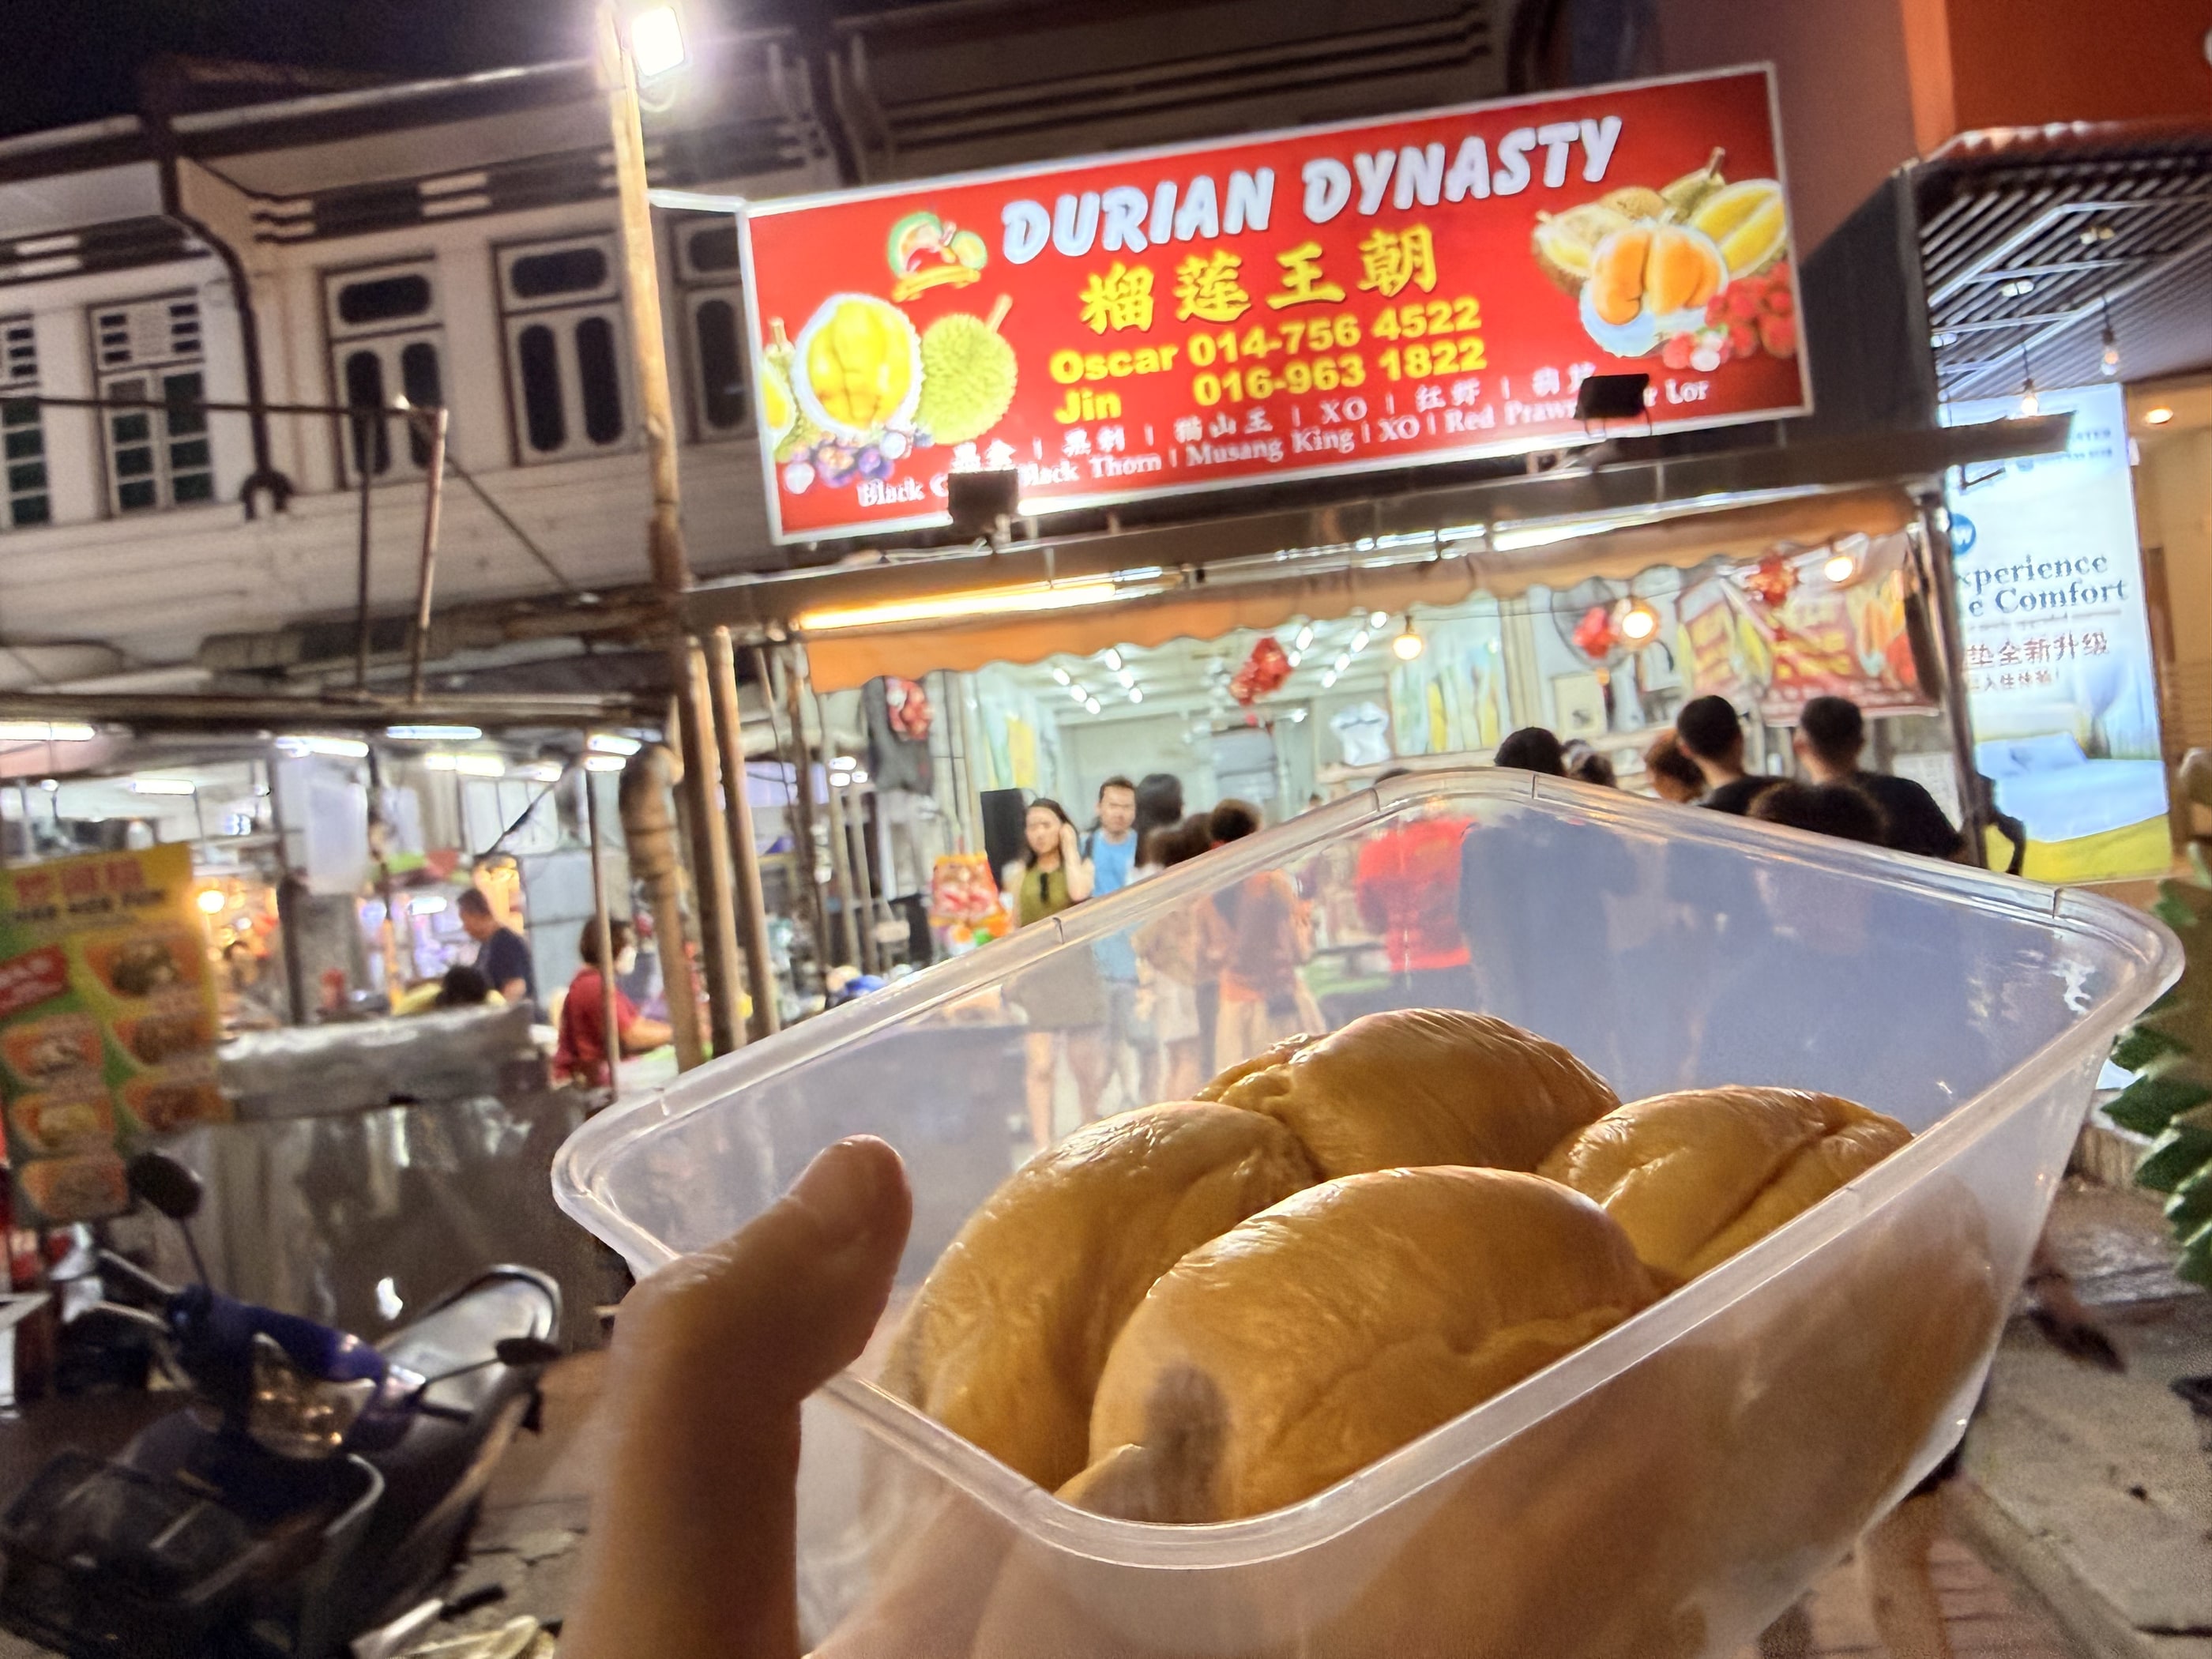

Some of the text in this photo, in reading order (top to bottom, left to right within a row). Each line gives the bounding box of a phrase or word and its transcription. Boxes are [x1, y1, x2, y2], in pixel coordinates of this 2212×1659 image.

[1001, 115, 1623, 264] DURIAN DYNASTY
[1079, 224, 1438, 334] 榴莲王朝
[1050, 296, 1482, 384] Oscar 014-756 4522
[1054, 336, 1487, 424] Jin 016-963 1822
[856, 477, 925, 506] Black
[1089, 453, 1162, 478] Thorn
[1186, 436, 1283, 463] Musang
[1291, 427, 1355, 453] King
[1379, 415, 1420, 442] XO
[1444, 404, 1495, 433] Red
[1665, 378, 1710, 404] Lor
[1319, 397, 1367, 424] XO
[1995, 577, 2127, 614] Comfort
